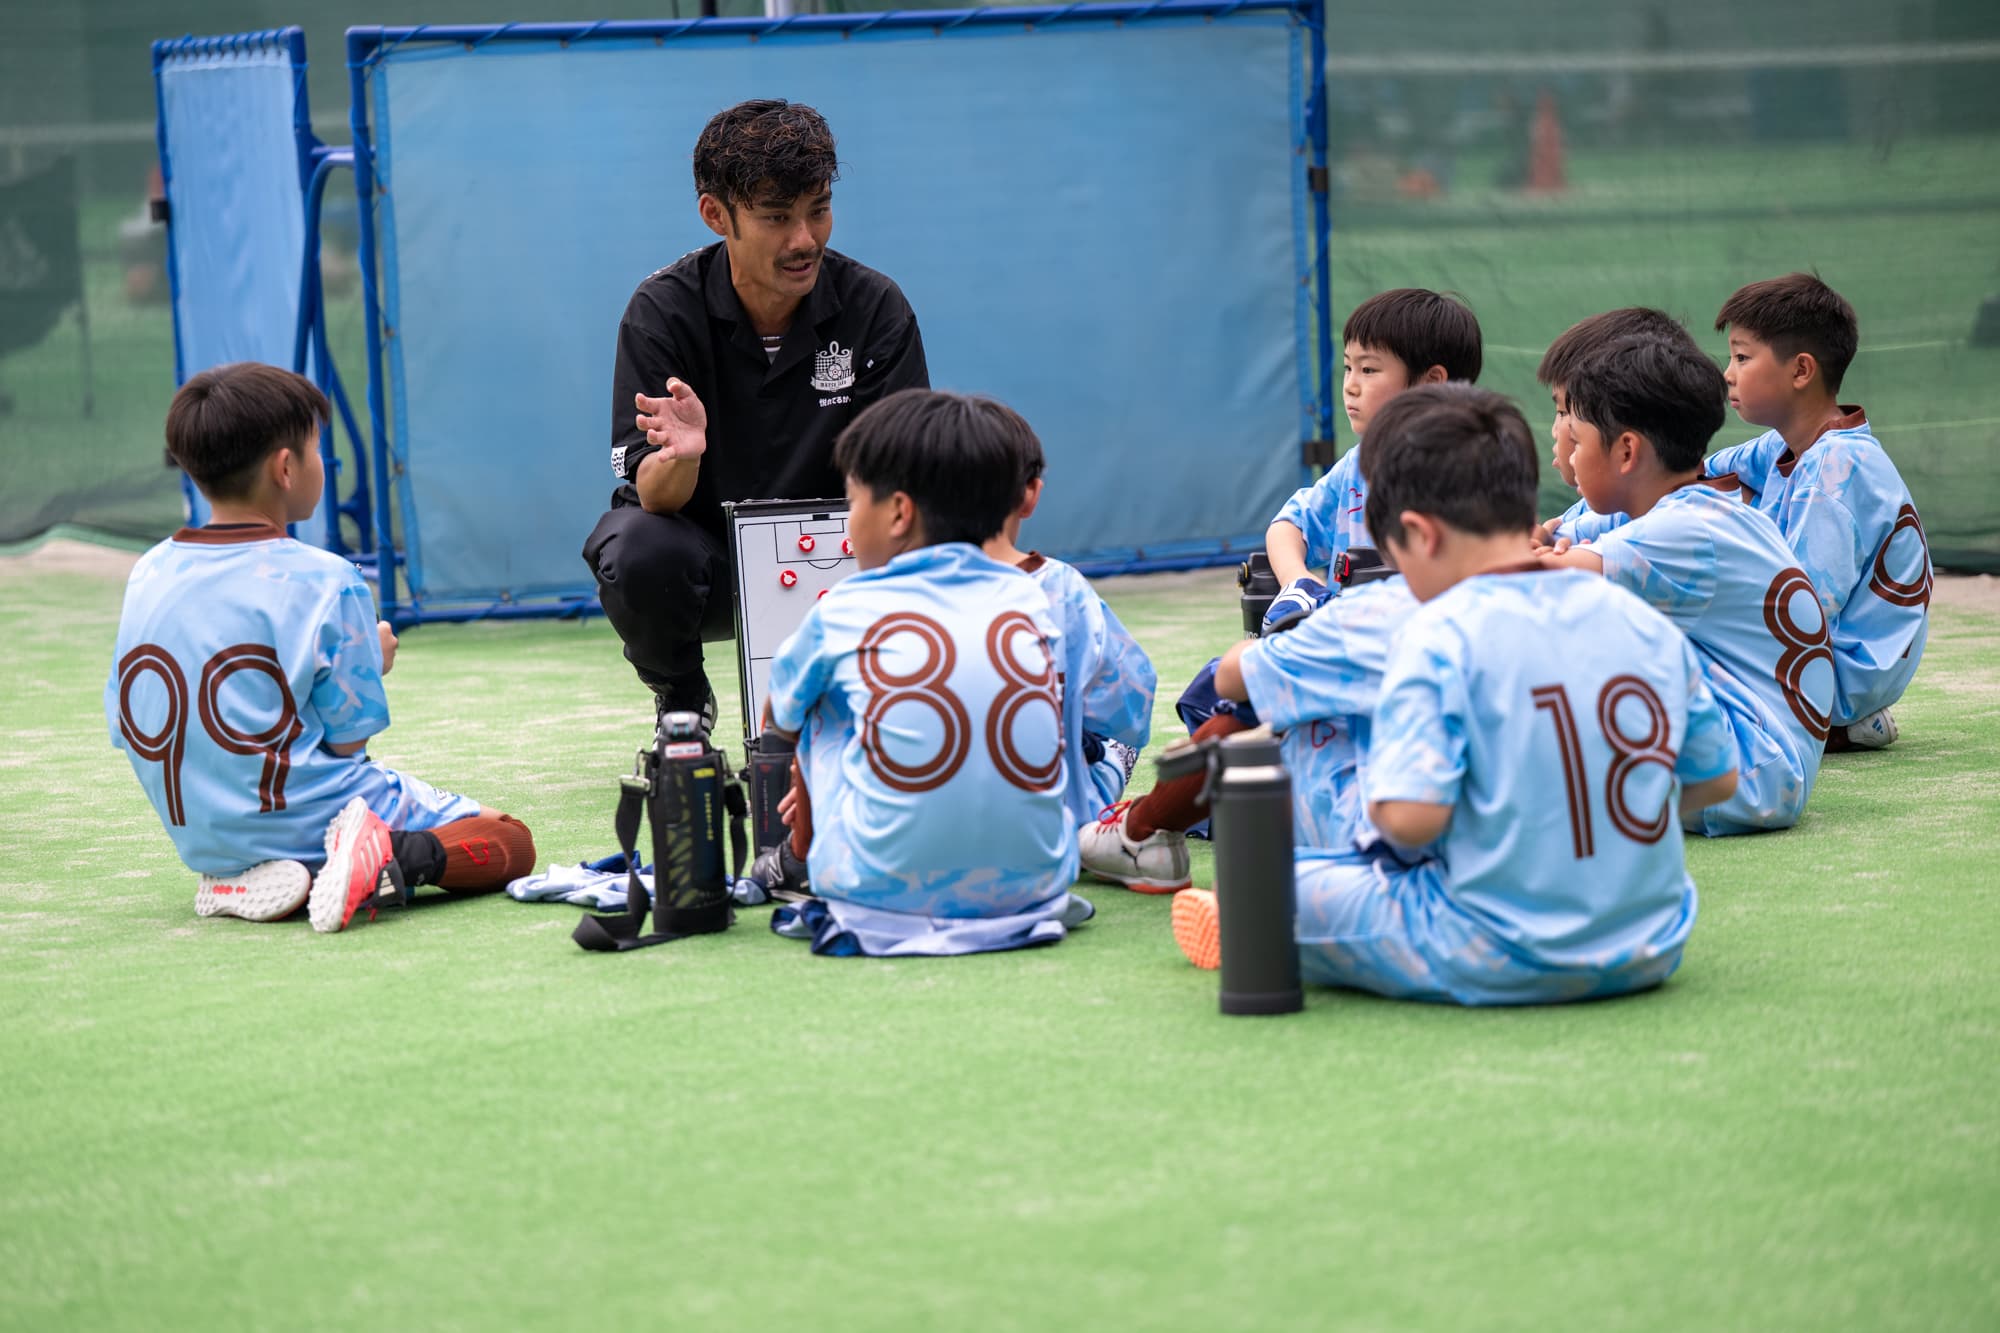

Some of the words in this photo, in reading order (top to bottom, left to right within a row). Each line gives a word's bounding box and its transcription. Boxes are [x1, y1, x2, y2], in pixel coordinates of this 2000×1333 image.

[118, 643, 304, 827] 99
[857, 610, 1065, 794] 88
[1530, 674, 1679, 859] 18
